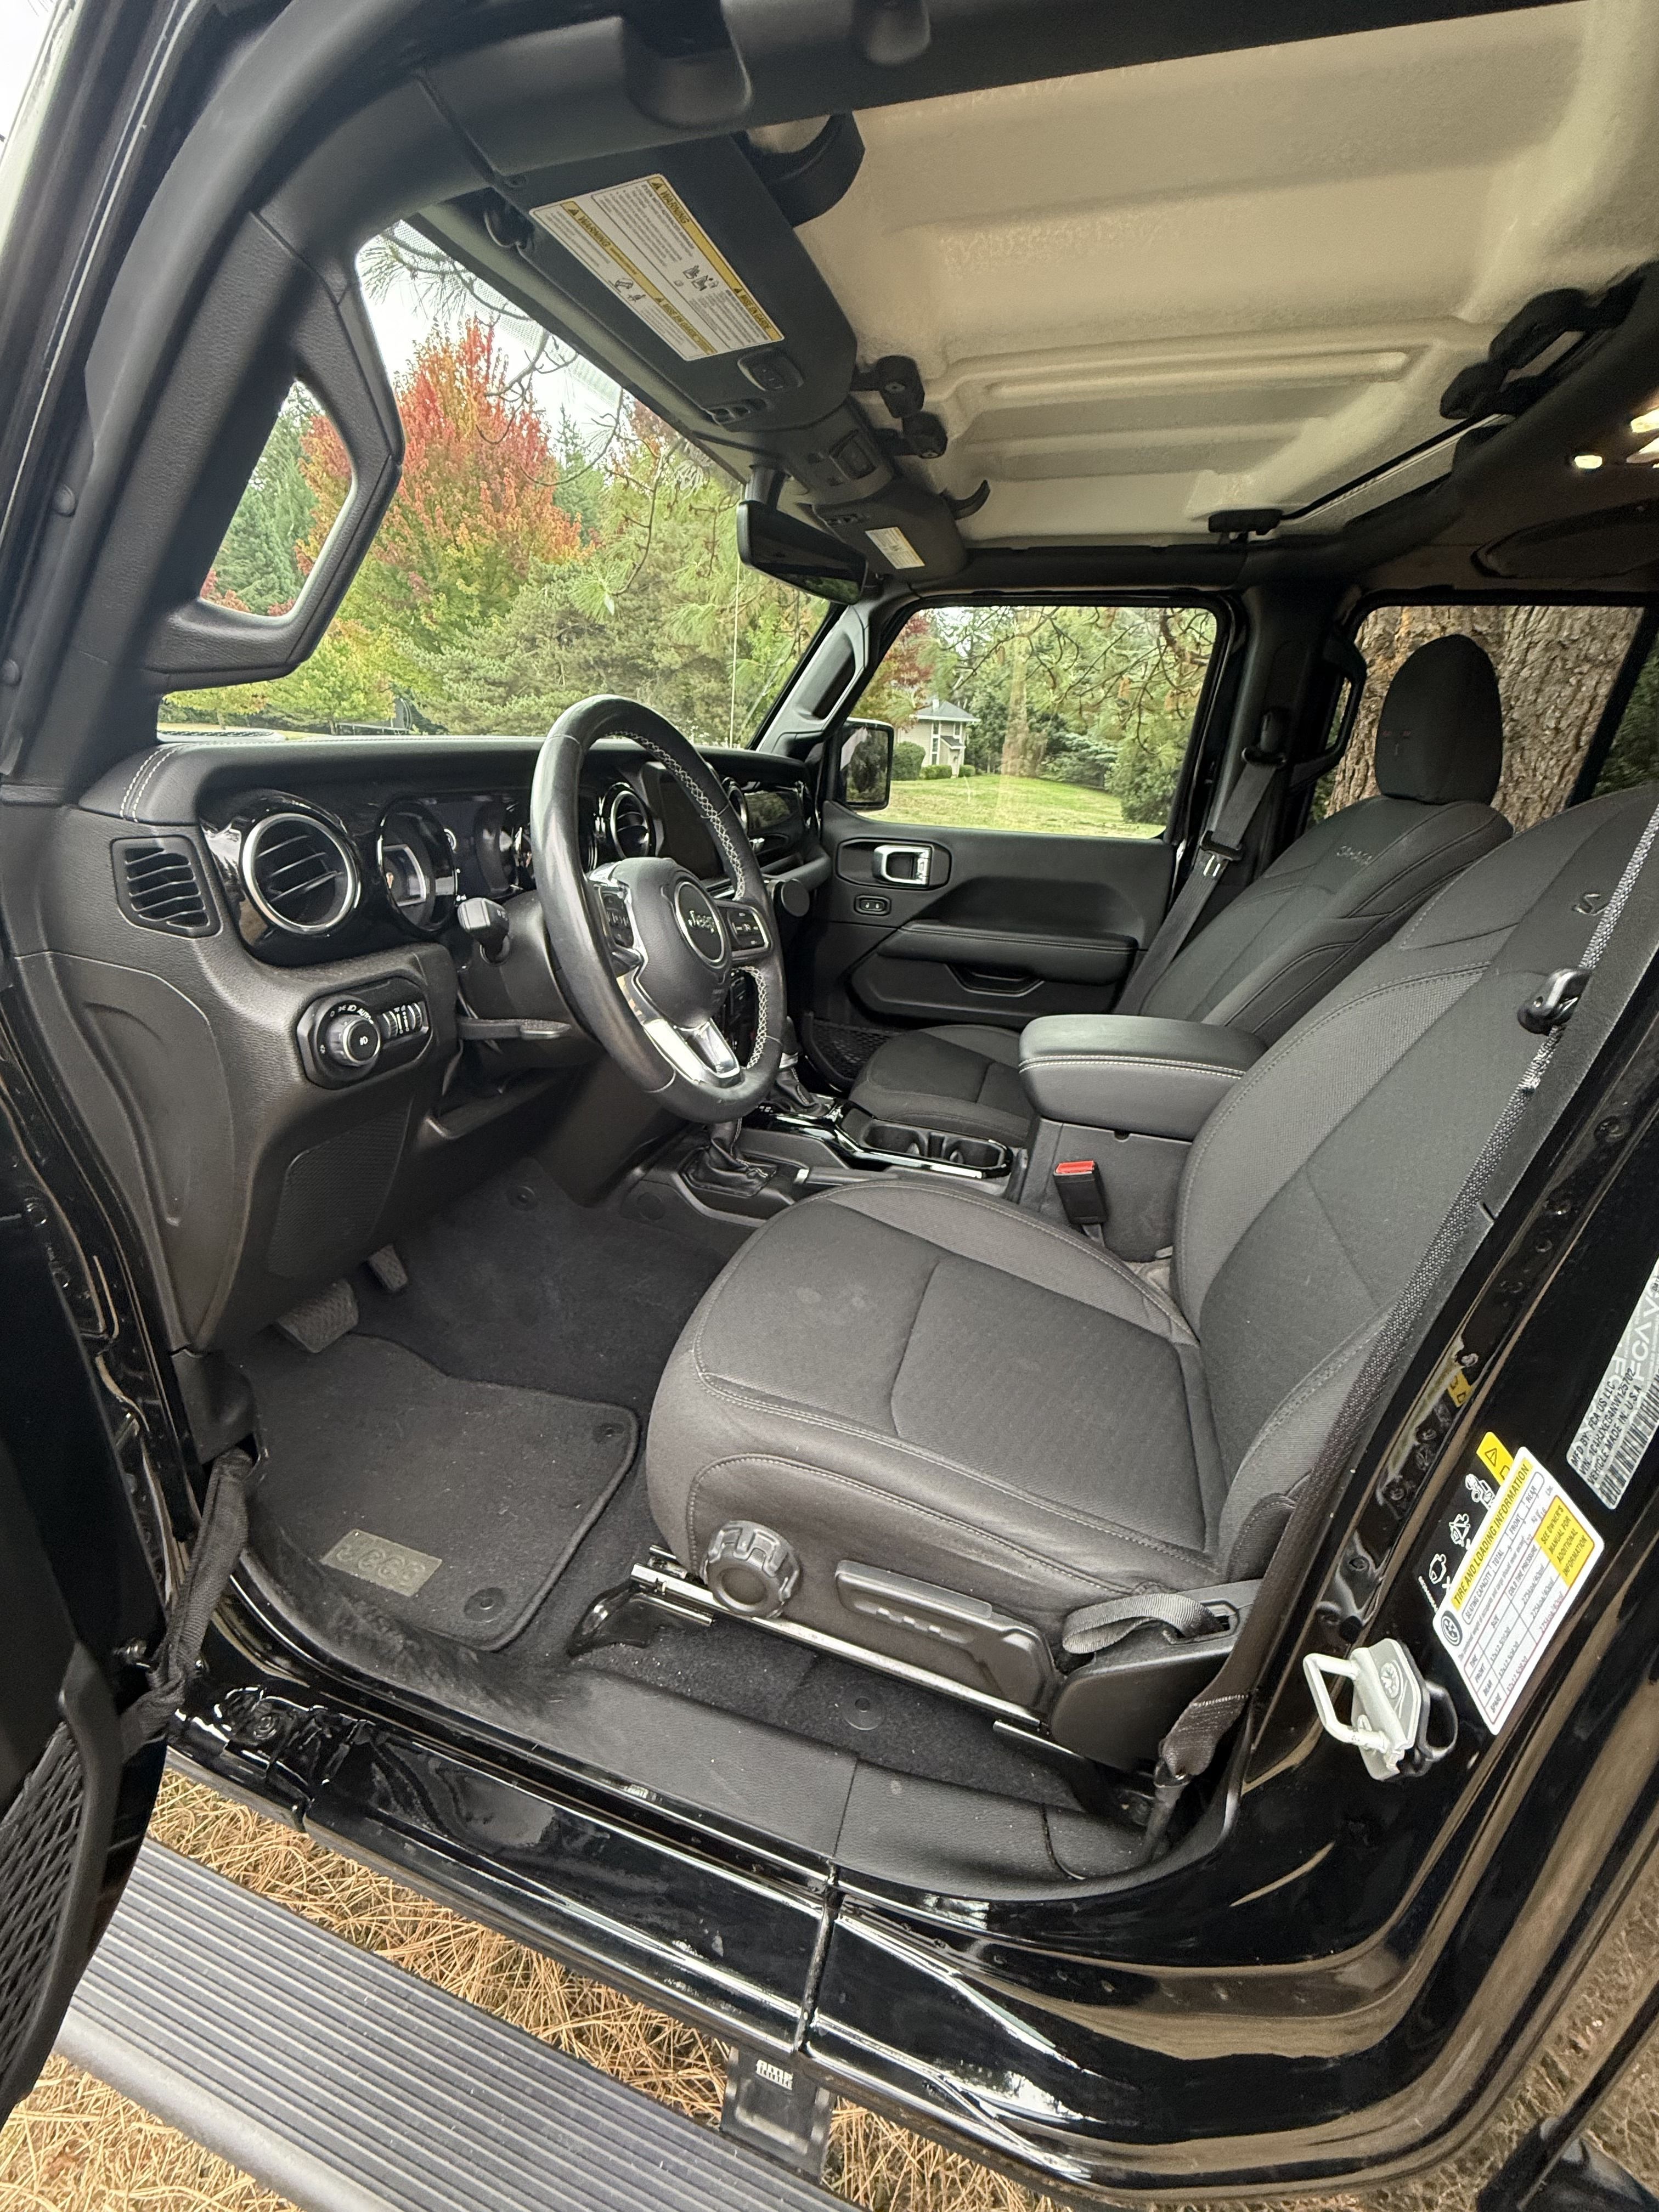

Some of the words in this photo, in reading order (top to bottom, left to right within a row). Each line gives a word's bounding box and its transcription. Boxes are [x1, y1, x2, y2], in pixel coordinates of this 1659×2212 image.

[659, 190, 689, 224] WARNING
[578, 216, 611, 247] WARNING
[688, 910, 714, 933] Jeep
[1570, 1445, 1584, 1466] MFD
[1588, 1412, 1601, 1430] FCA
[1596, 1397, 1607, 1412] US
[1602, 1381, 1615, 1399] LLC
[1587, 1449, 1609, 1484] VEHICLE
[1604, 1423, 1622, 1451] MADE
[1525, 1485, 1537, 1503] REAR
[1453, 1581, 1467, 1604] TIRE
[1464, 1564, 1477, 1585] AND
[1472, 1525, 1497, 1565] LOADING
[1493, 1463, 1530, 1528] INFORMATION
[1509, 1513, 1522, 1534] FRONT
[1540, 1531, 1549, 1544] SEE
[1545, 1505, 1564, 1533] OWNER'S
[1548, 1528, 1564, 1554] MANUAL
[1561, 1515, 1571, 1530] FOR
[1492, 1549, 1504, 1566] TOTAL
[1556, 1527, 1578, 1563] ADDITIONAL
[1562, 1534, 1587, 1576] INFORMATION
[336, 1543, 426, 1587] Jeep
[1514, 1568, 1524, 1582] TIRE
[1521, 1544, 1537, 1571] PRESSURE
[1464, 1596, 1479, 1619] SEATING
[1476, 1570, 1492, 1597] CAPACITY
[1491, 1614, 1499, 1628] SIZE
[1469, 1654, 1477, 1668] TIRE
[1474, 1663, 1486, 1683] FRONT
[1483, 1679, 1493, 1696] REAR
[1490, 1692, 1501, 1713] SPARE
